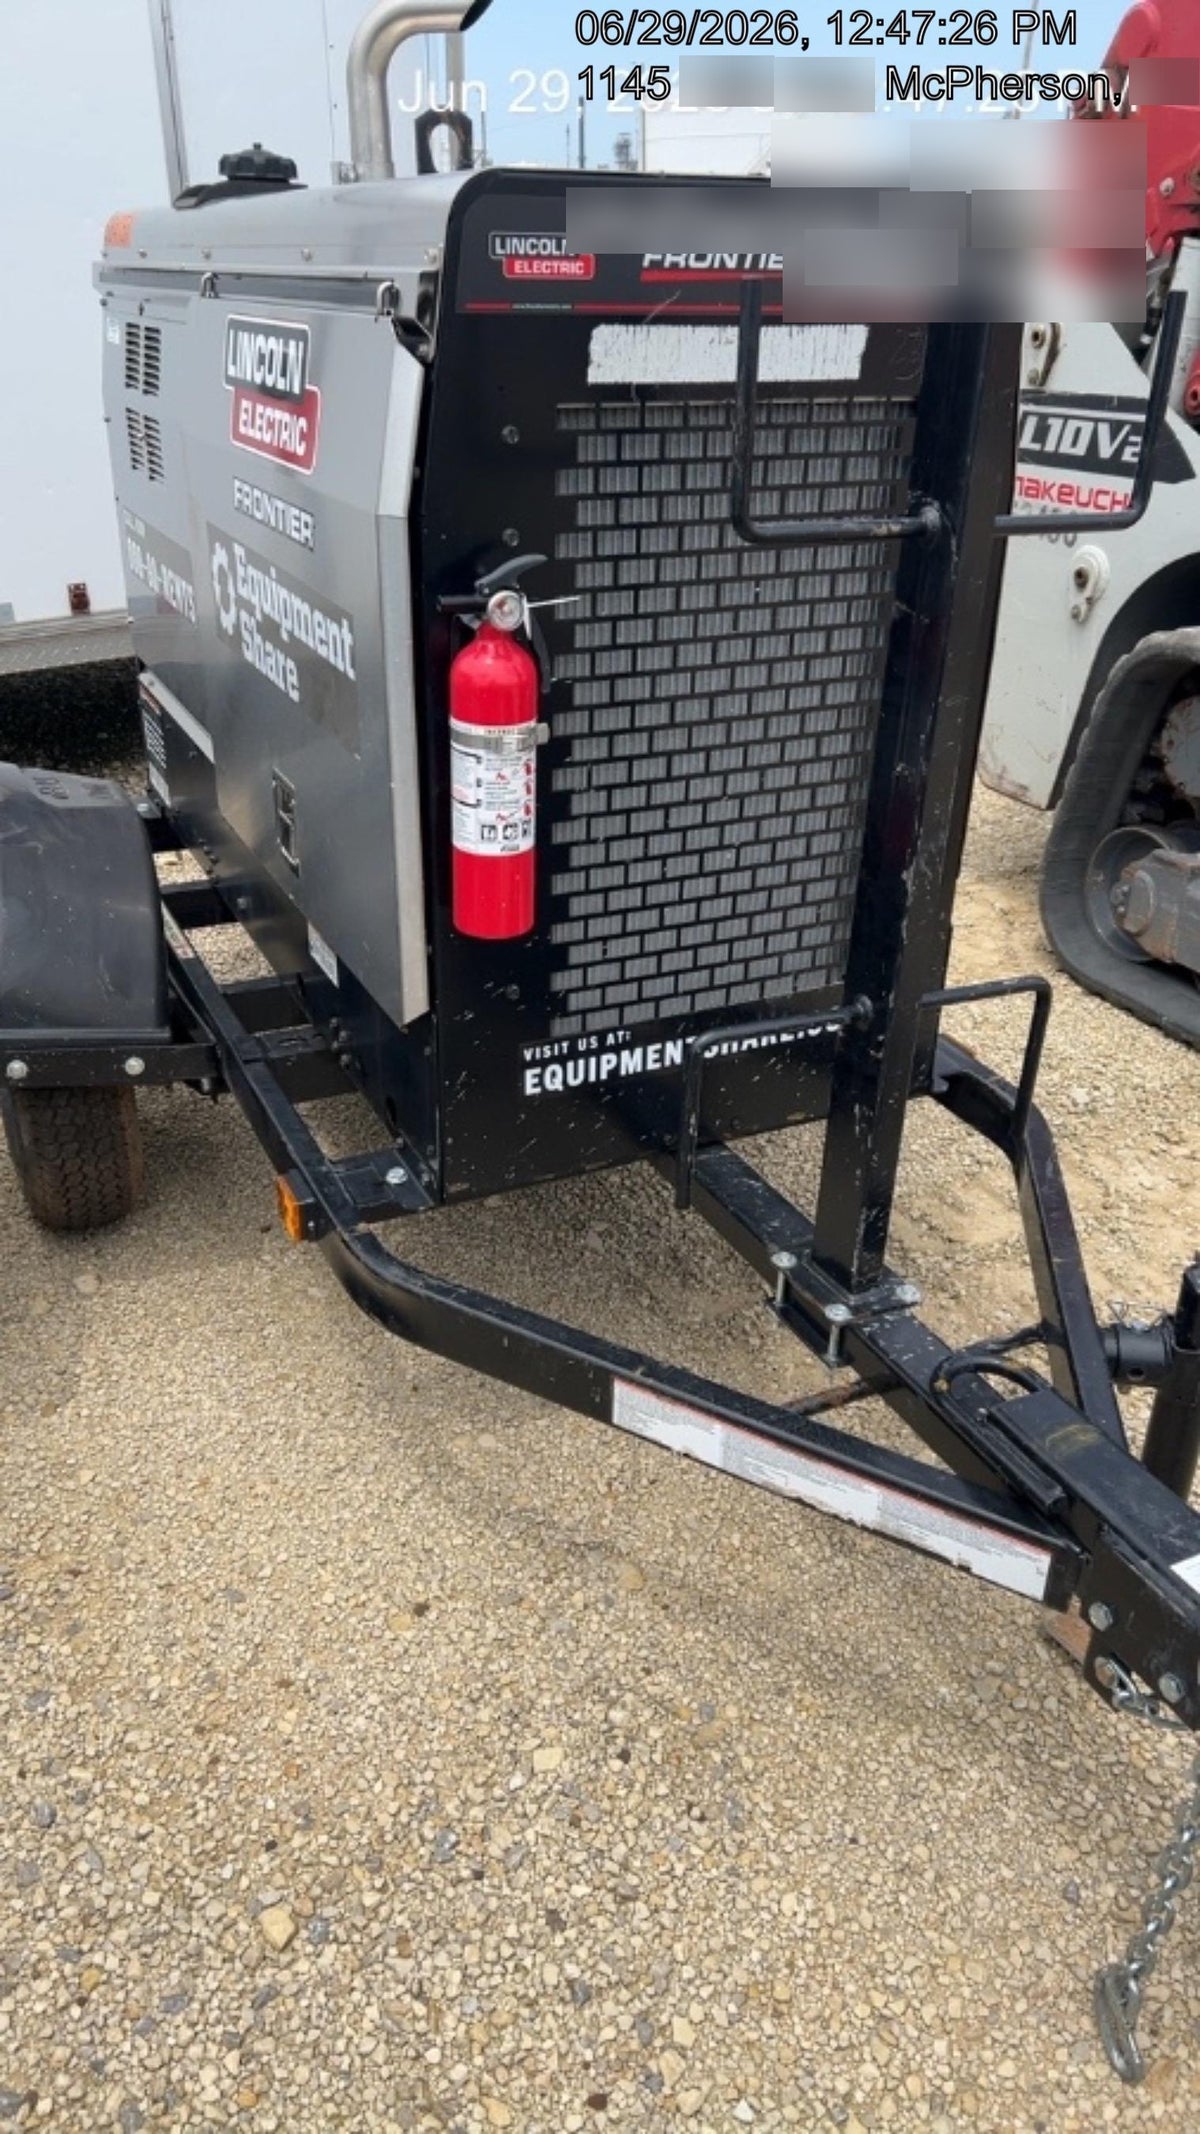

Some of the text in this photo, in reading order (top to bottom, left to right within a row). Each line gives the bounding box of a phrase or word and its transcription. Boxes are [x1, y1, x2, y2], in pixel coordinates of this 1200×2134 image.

[514, 260, 584, 275] ELECTRIC
[642, 253, 784, 269] FRONTIE
[227, 329, 304, 394] LINCOLN
[239, 398, 308, 457] ELECTRIC
[1020, 415, 1142, 463] L10V2
[234, 479, 314, 548] FRONTIER
[234, 542, 356, 677] Equipment
[240, 609, 300, 702] Share
[523, 1031, 632, 1062] VISIT US AT:
